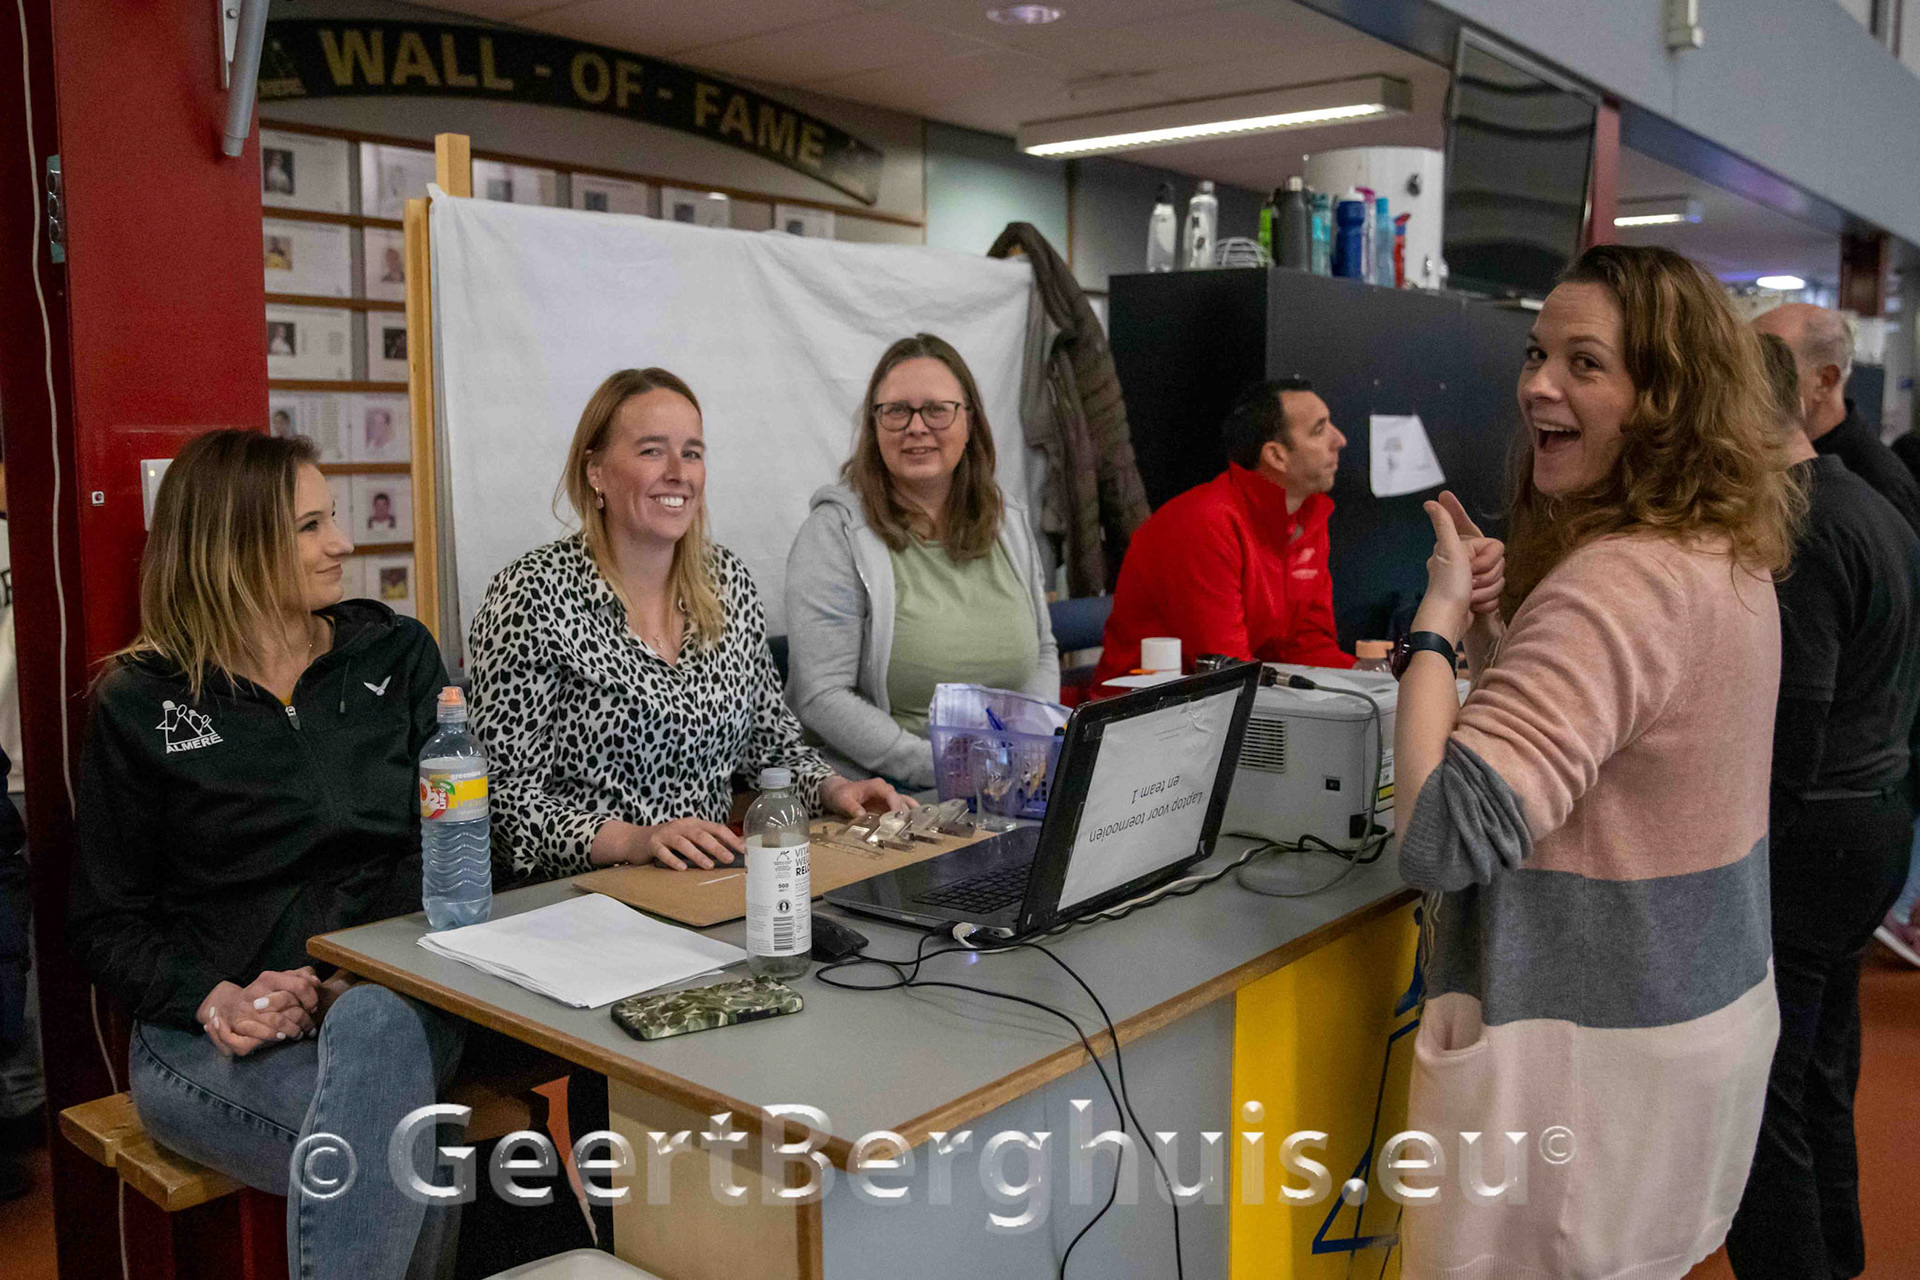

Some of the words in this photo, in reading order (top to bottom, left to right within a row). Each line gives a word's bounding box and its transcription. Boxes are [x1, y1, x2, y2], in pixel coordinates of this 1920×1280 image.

[319, 29, 514, 91] WALL
[570, 52, 643, 108] OF
[695, 82, 826, 168] FAME
[166, 734, 223, 755] ALMERE
[1140, 780, 1166, 798] team
[1167, 775, 1180, 788] en
[1131, 789, 1138, 805] 1
[1171, 791, 1204, 812] Laptop
[1146, 804, 1169, 820] voor
[1089, 812, 1146, 842] toernooien
